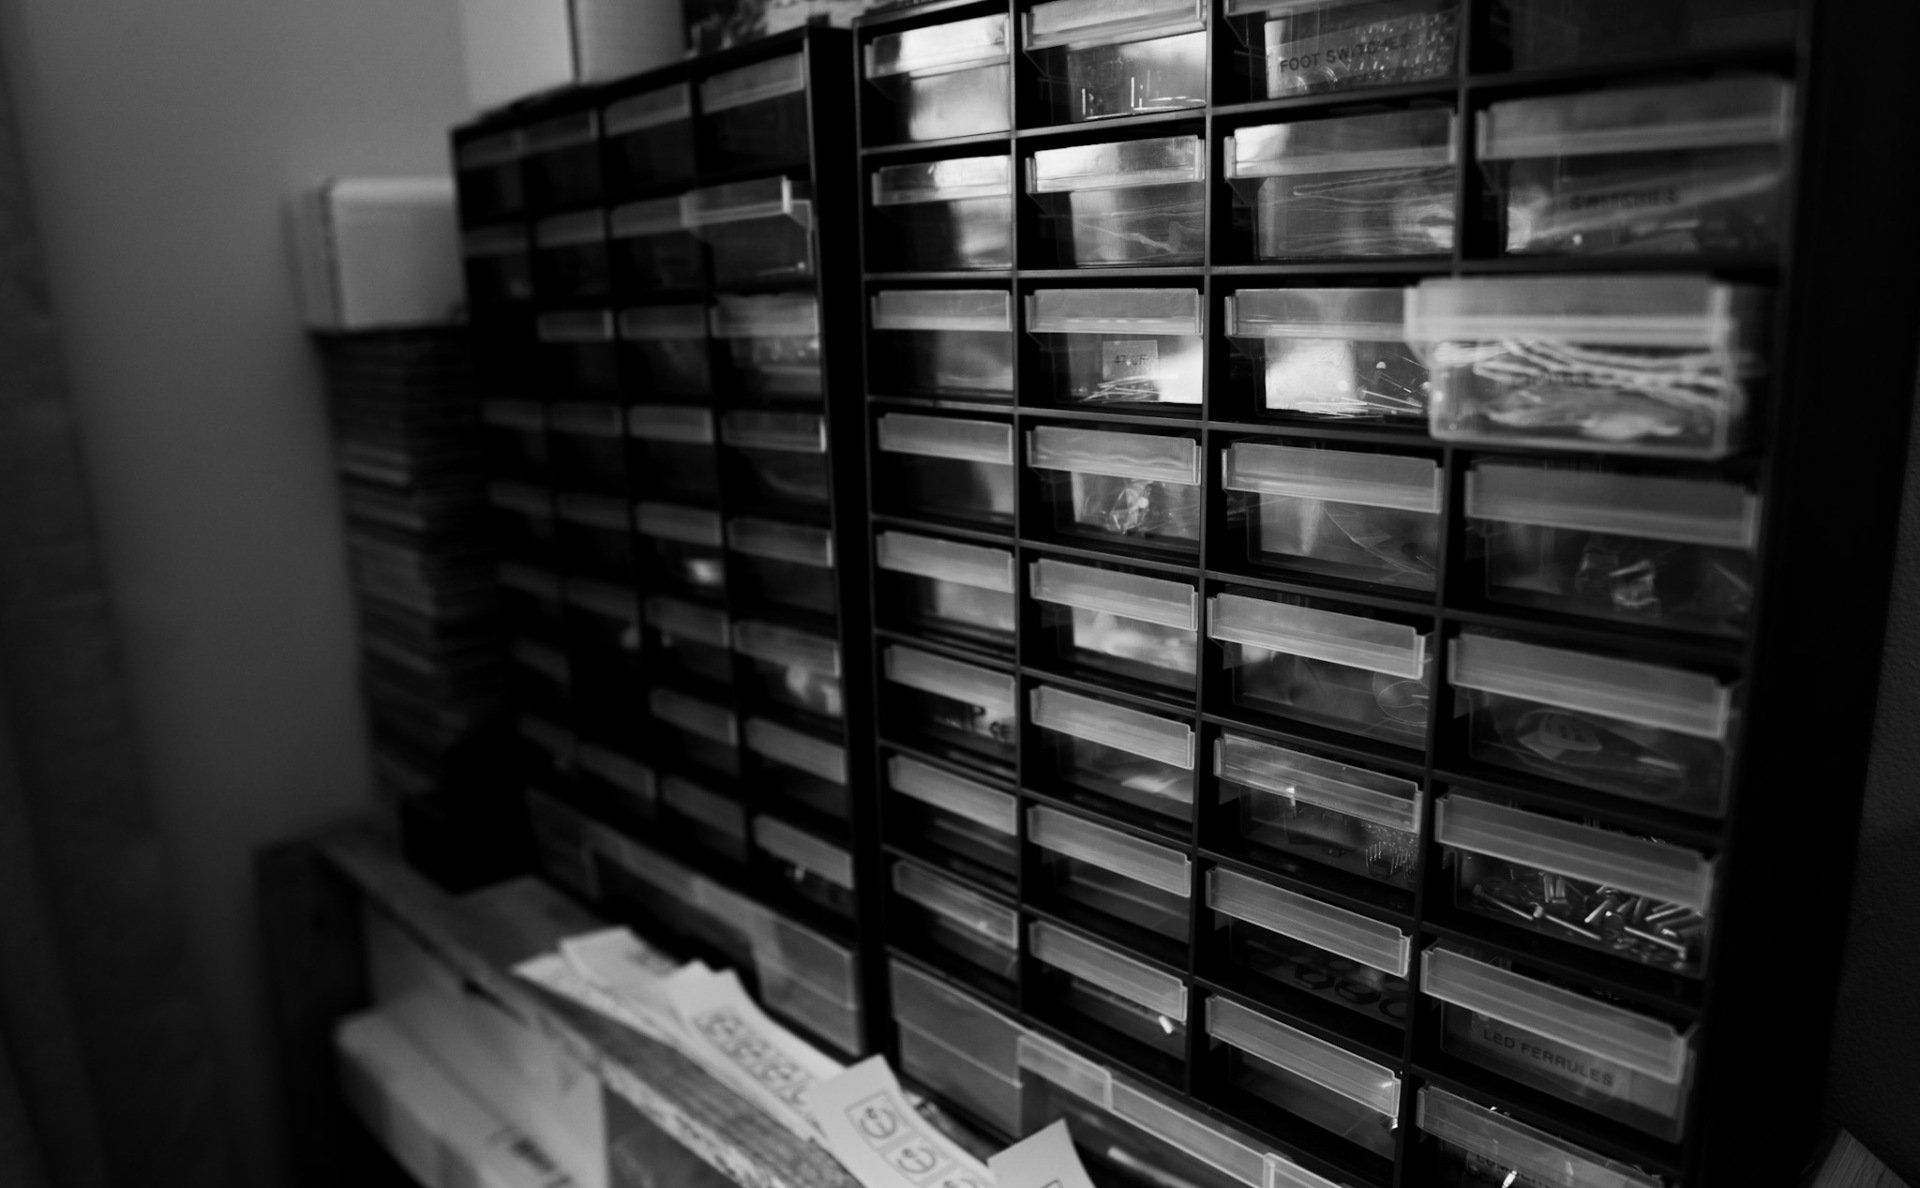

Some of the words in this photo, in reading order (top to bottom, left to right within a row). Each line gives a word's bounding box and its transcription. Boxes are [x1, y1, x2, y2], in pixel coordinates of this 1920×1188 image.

[1280, 53, 1320, 72] FOOT
[1483, 1028, 1516, 1049] LED
[1521, 1044, 1615, 1087] FERRULES
